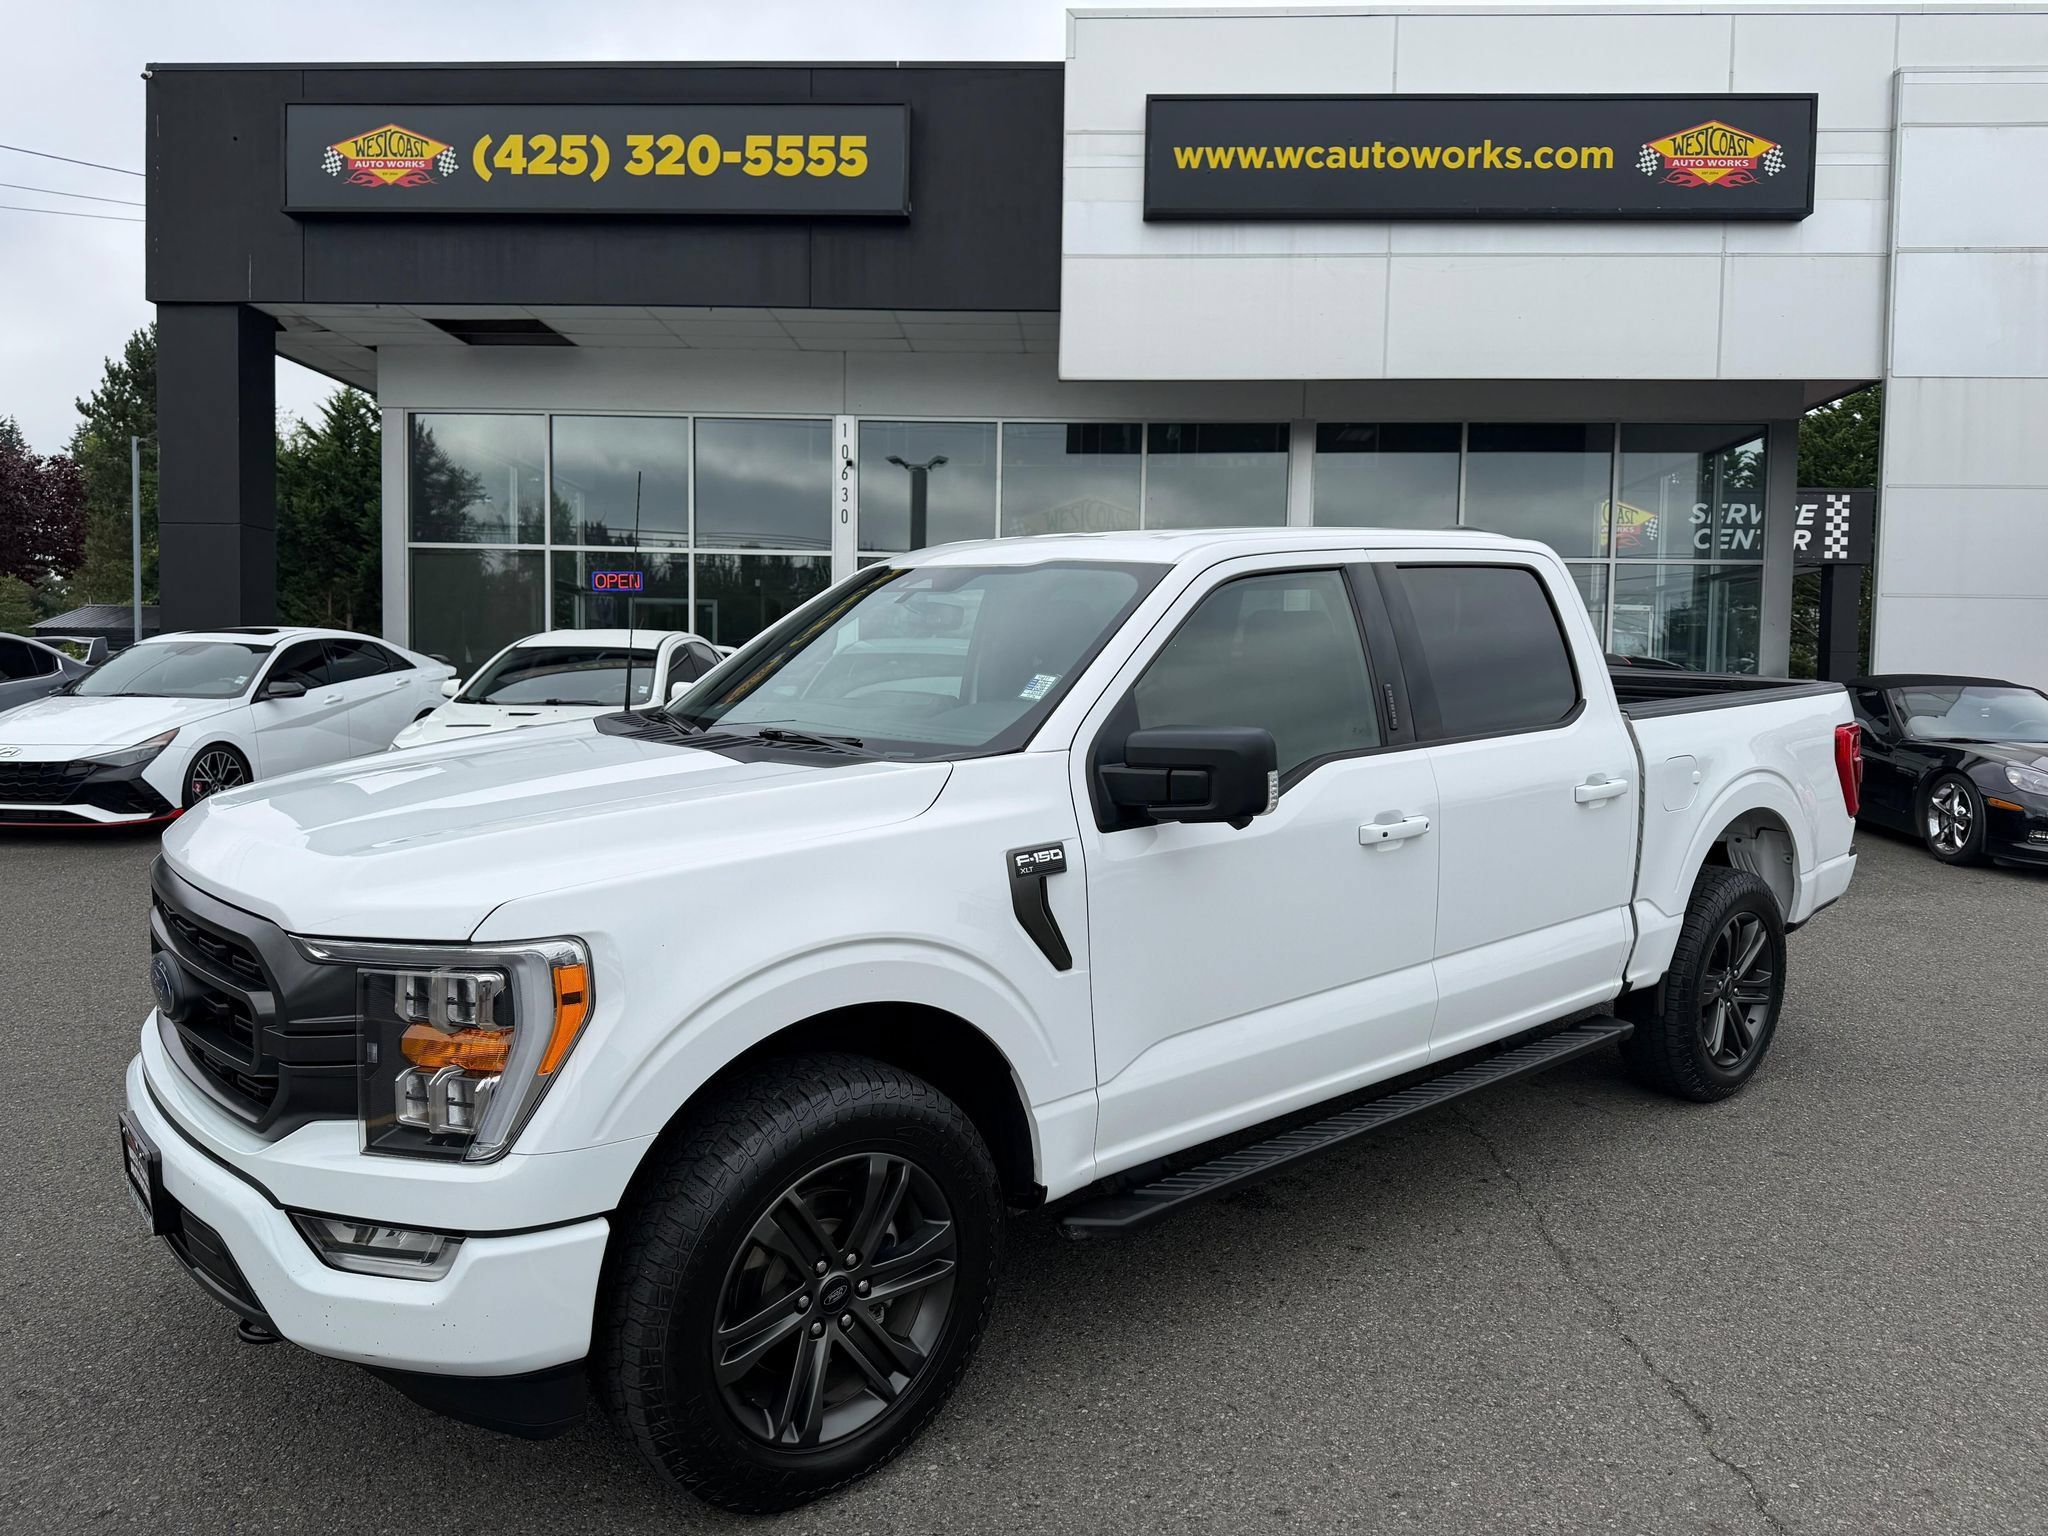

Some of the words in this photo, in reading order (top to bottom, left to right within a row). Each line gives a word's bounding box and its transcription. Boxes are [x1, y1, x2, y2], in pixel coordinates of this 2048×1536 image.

[473, 134, 610, 182] (425)
[624, 135, 868, 177] 320-5555
[1174, 139, 1614, 170] www.wcautoworks.com
[354, 160, 385, 168] AUTO
[389, 160, 425, 168] WORKS
[1672, 159, 1705, 167] AUTO
[1709, 159, 1750, 167] WORKS
[595, 573, 641, 589] OPEN
[1015, 849, 1063, 867] F-150
[1020, 866, 1034, 874] XLT
